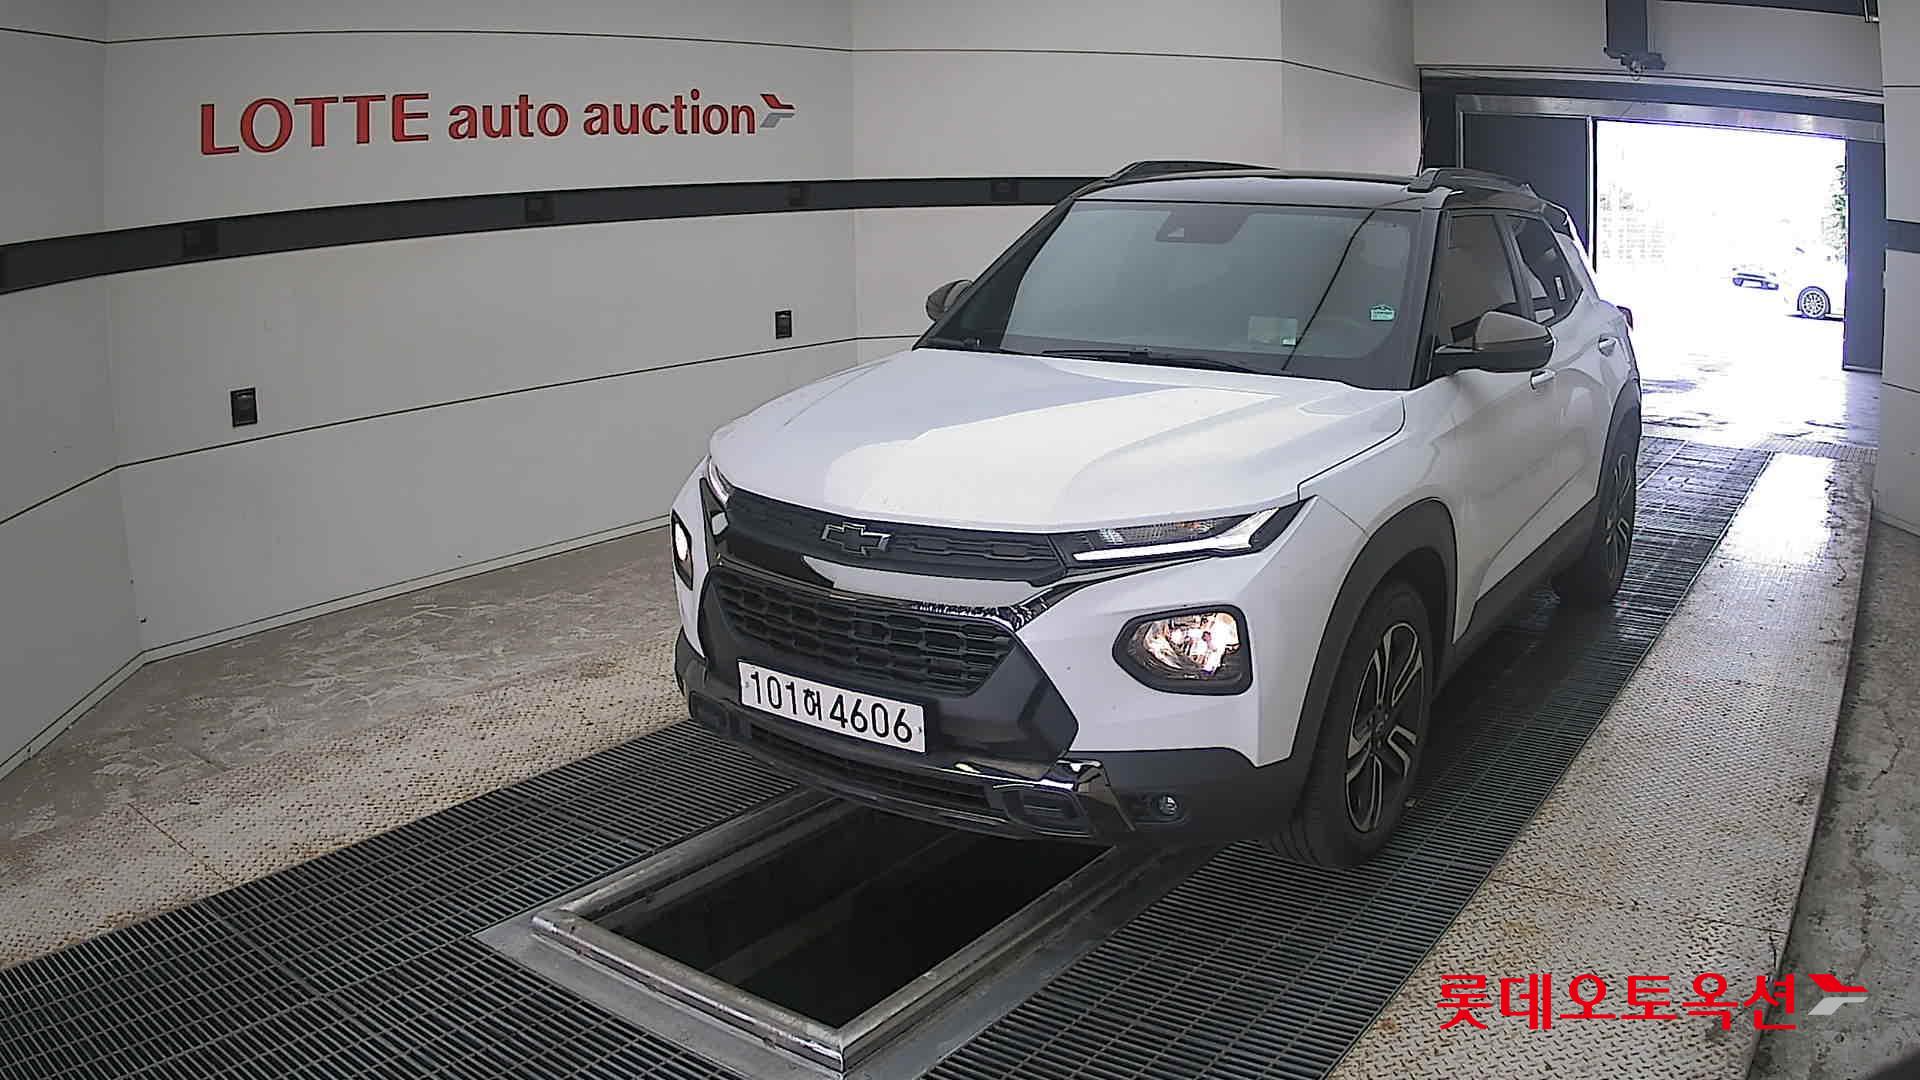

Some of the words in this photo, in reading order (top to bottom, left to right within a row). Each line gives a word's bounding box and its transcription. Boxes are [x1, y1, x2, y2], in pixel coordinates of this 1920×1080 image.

[201, 93, 430, 155] LOTTE
[448, 95, 569, 140] auto
[583, 88, 756, 136] auction
